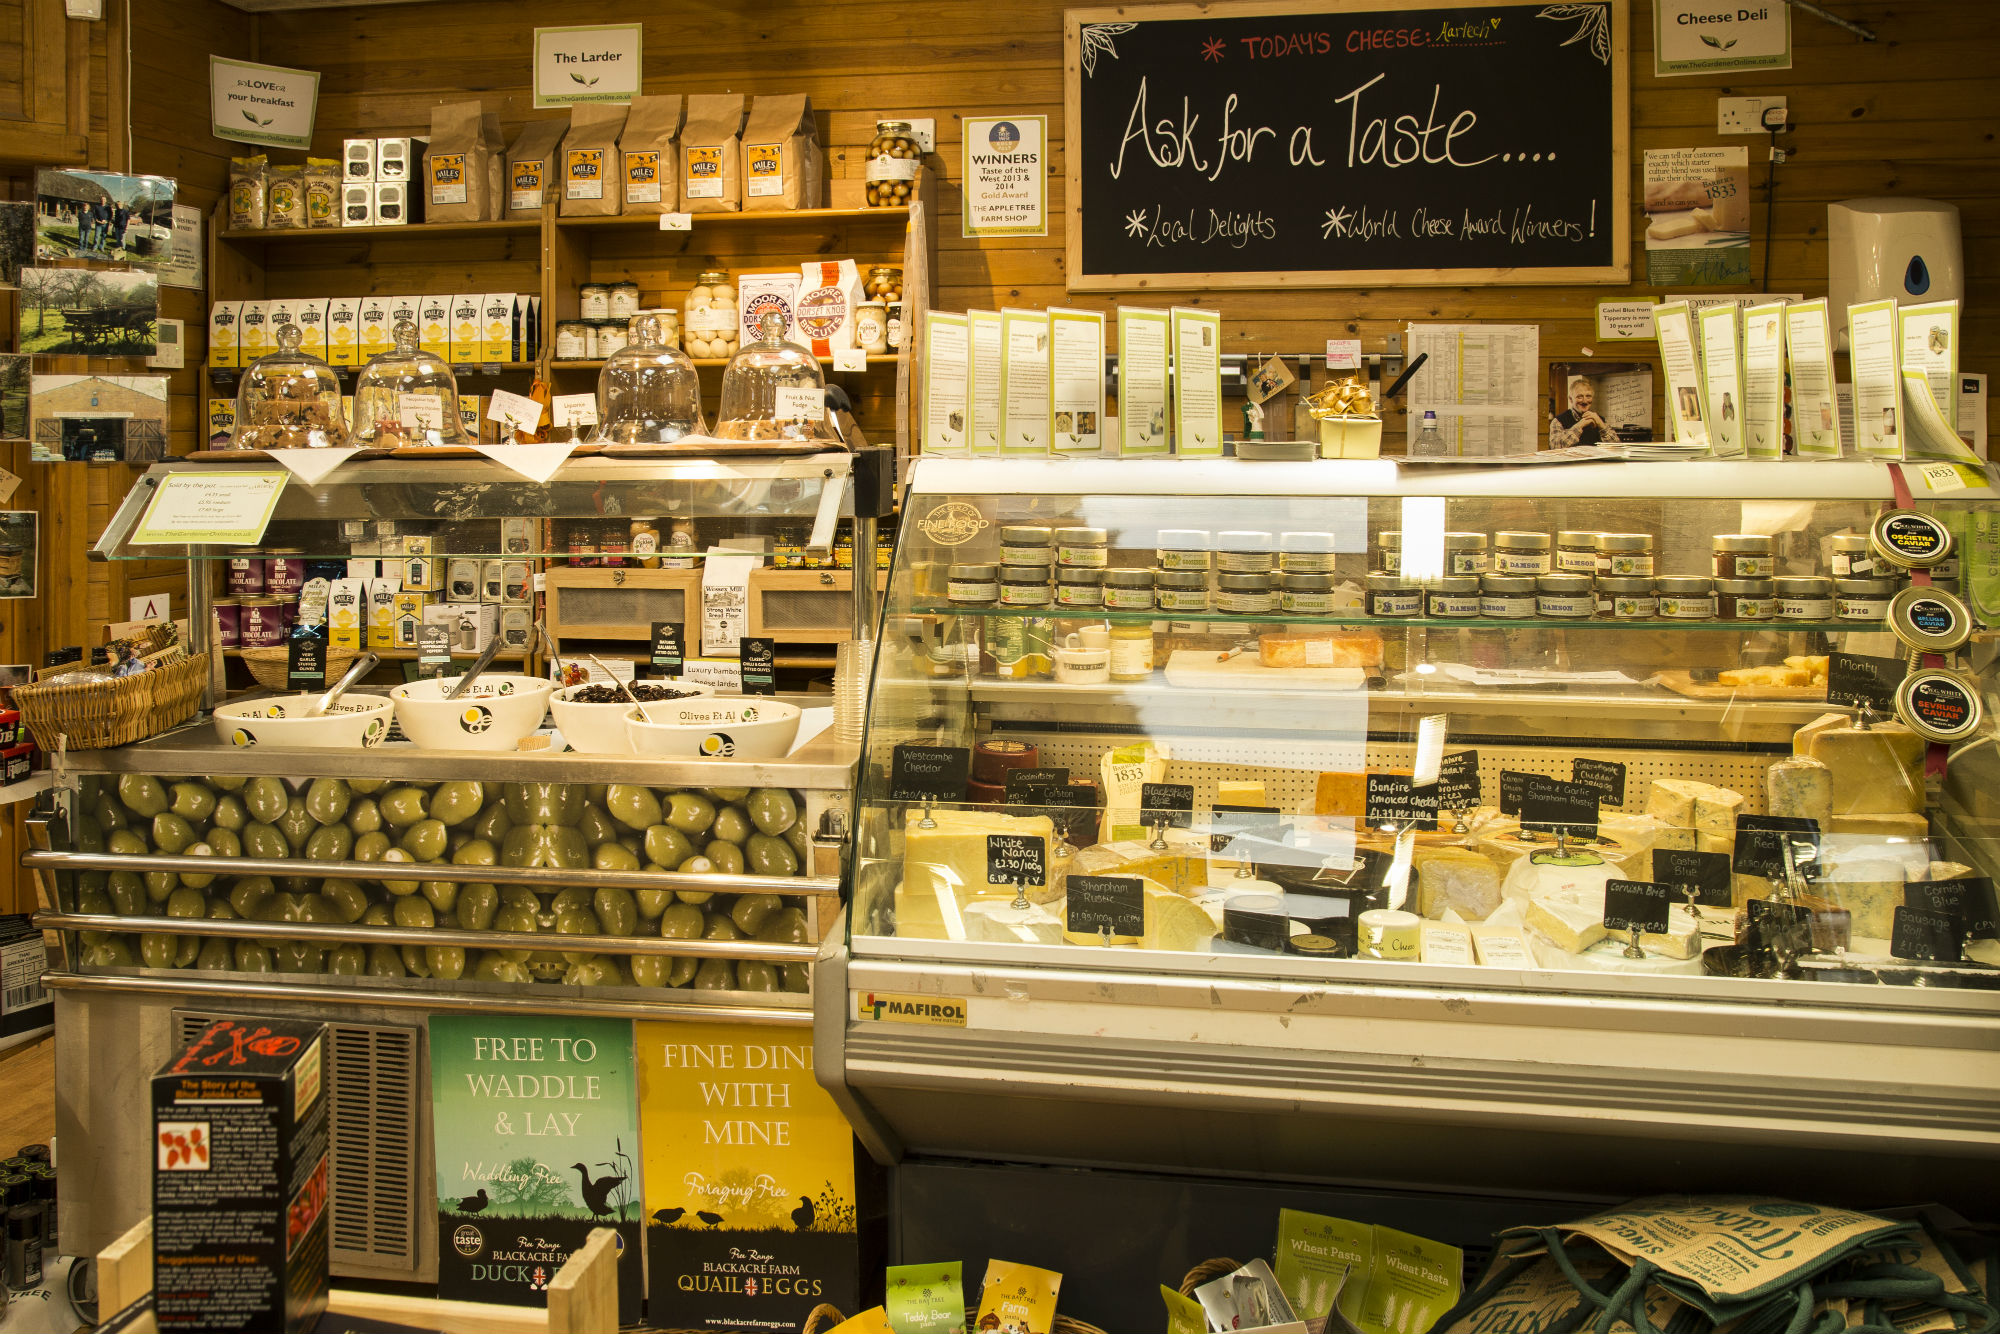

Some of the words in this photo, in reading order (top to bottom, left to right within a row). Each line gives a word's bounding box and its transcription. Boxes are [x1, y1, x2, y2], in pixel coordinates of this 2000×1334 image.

[1677, 13, 1732, 25] Cheese
[1738, 9, 1768, 21] Deli
[1241, 33, 1331, 59] TODAY'S
[554, 53, 578, 64] The
[581, 51, 622, 63] Larder
[1669, 58, 1777, 70] www.TheGardenerOnline.co.uk
[247, 79, 276, 92] LOVE
[227, 91, 248, 102] your
[250, 94, 295, 108] breakfast
[1110, 76, 1208, 180] Ask
[1208, 93, 1277, 182] for
[1290, 126, 1325, 166] a
[972, 153, 1038, 165] WINNERS
[1670, 151, 1681, 159] tell
[1693, 151, 1725, 159] customers
[753, 161, 776, 171] MILES
[1649, 160, 1670, 168] exactly
[1672, 159, 1690, 167] which
[1691, 159, 1710, 167] starter
[1671, 166, 1689, 174] blend
[631, 168, 654, 178] MILES
[1002, 191, 1029, 199] Award
[1705, 184, 1737, 199] 1833
[989, 204, 1014, 212] APPLE
[1147, 204, 1198, 247] Local
[1202, 208, 1276, 249] Delights
[1347, 205, 1401, 242] World
[1411, 208, 1454, 237] Cheese
[1460, 206, 1506, 241] Award
[801, 287, 843, 306] MOORES
[750, 294, 791, 314] MOORES
[797, 307, 824, 316] DORSET
[825, 306, 846, 314] KNOB
[800, 316, 842, 337] BISCUITS
[1928, 469, 1954, 480] 1833
[917, 519, 946, 530] FINE
[948, 519, 990, 530] FOOD
[1891, 534, 1935, 542] OSCIETRA
[1975, 522, 1986, 544] PVC
[1510, 561, 1540, 569] DAMSON
[1565, 559, 1595, 567] DAMSON
[1933, 565, 1950, 573] FIG
[1542, 604, 1573, 612] DAMSON
[243, 630, 273, 638] CHOCOLATE
[687, 666, 711, 675] Luxury
[1840, 658, 1878, 680] Monty
[717, 679, 738, 688] larder
[327, 702, 354, 713] Olives
[1918, 700, 1963, 713] SEVRUGA
[679, 710, 710, 721] Olives
[712, 711, 724, 720] Et
[727, 711, 736, 720] Al
[1923, 708, 1959, 719] CAVIAR
[1115, 768, 1144, 783] 1833
[1369, 779, 1410, 794] Bonfire
[1570, 795, 1595, 808] Rustic
[989, 837, 1024, 849] White
[1002, 848, 1039, 862] Nancy
[1674, 866, 1698, 876] Blue
[1080, 881, 1128, 894] Sharpham
[1610, 882, 1644, 895] Cornish
[1646, 886, 1666, 898] Brie
[1924, 884, 1967, 896] Cornish
[1931, 895, 1960, 907] Blue
[1899, 912, 1950, 930] Sausage
[888, 1001, 965, 1019] MAFIROL
[473, 1037, 544, 1062] FREE
[550, 1038, 597, 1062] TO
[663, 1044, 735, 1069] FINE
[181, 1080, 198, 1089] The
[202, 1080, 225, 1090] Story
[229, 1080, 238, 1089] of
[240, 1080, 256, 1089] the
[465, 1073, 601, 1100] WADDLE
[699, 1082, 792, 1108] WITH
[494, 1111, 516, 1135] &
[523, 1112, 583, 1136] LAY
[703, 1120, 790, 1146] MINE
[462, 1161, 530, 1190] Waddling
[531, 1163, 563, 1187] Free
[683, 1171, 756, 1205] Foraging
[755, 1174, 790, 1199] Free
[455, 1234, 482, 1246] taste
[517, 1236, 534, 1249] Free
[535, 1237, 562, 1251] Range
[729, 1247, 747, 1260] Free
[748, 1249, 775, 1263] Range
[1291, 1238, 1328, 1257] Wheat
[1331, 1247, 1362, 1264] Pasta
[470, 1264, 531, 1282] DUCK
[703, 1262, 767, 1274] BLACKACRE
[768, 1264, 800, 1275] FARM
[1386, 1254, 1419, 1273] Wheat
[1421, 1268, 1449, 1287] Pasta
[677, 1274, 743, 1293] QUAIL
[761, 1277, 822, 1296] EGGS
[10, 1289, 52, 1301] TREE
[1001, 1302, 1029, 1316] Farm
[904, 1311, 930, 1323] Teddy
[931, 1309, 951, 1321] Bear
[705, 1317, 796, 1329] www.blackacrefarmeggs.com
